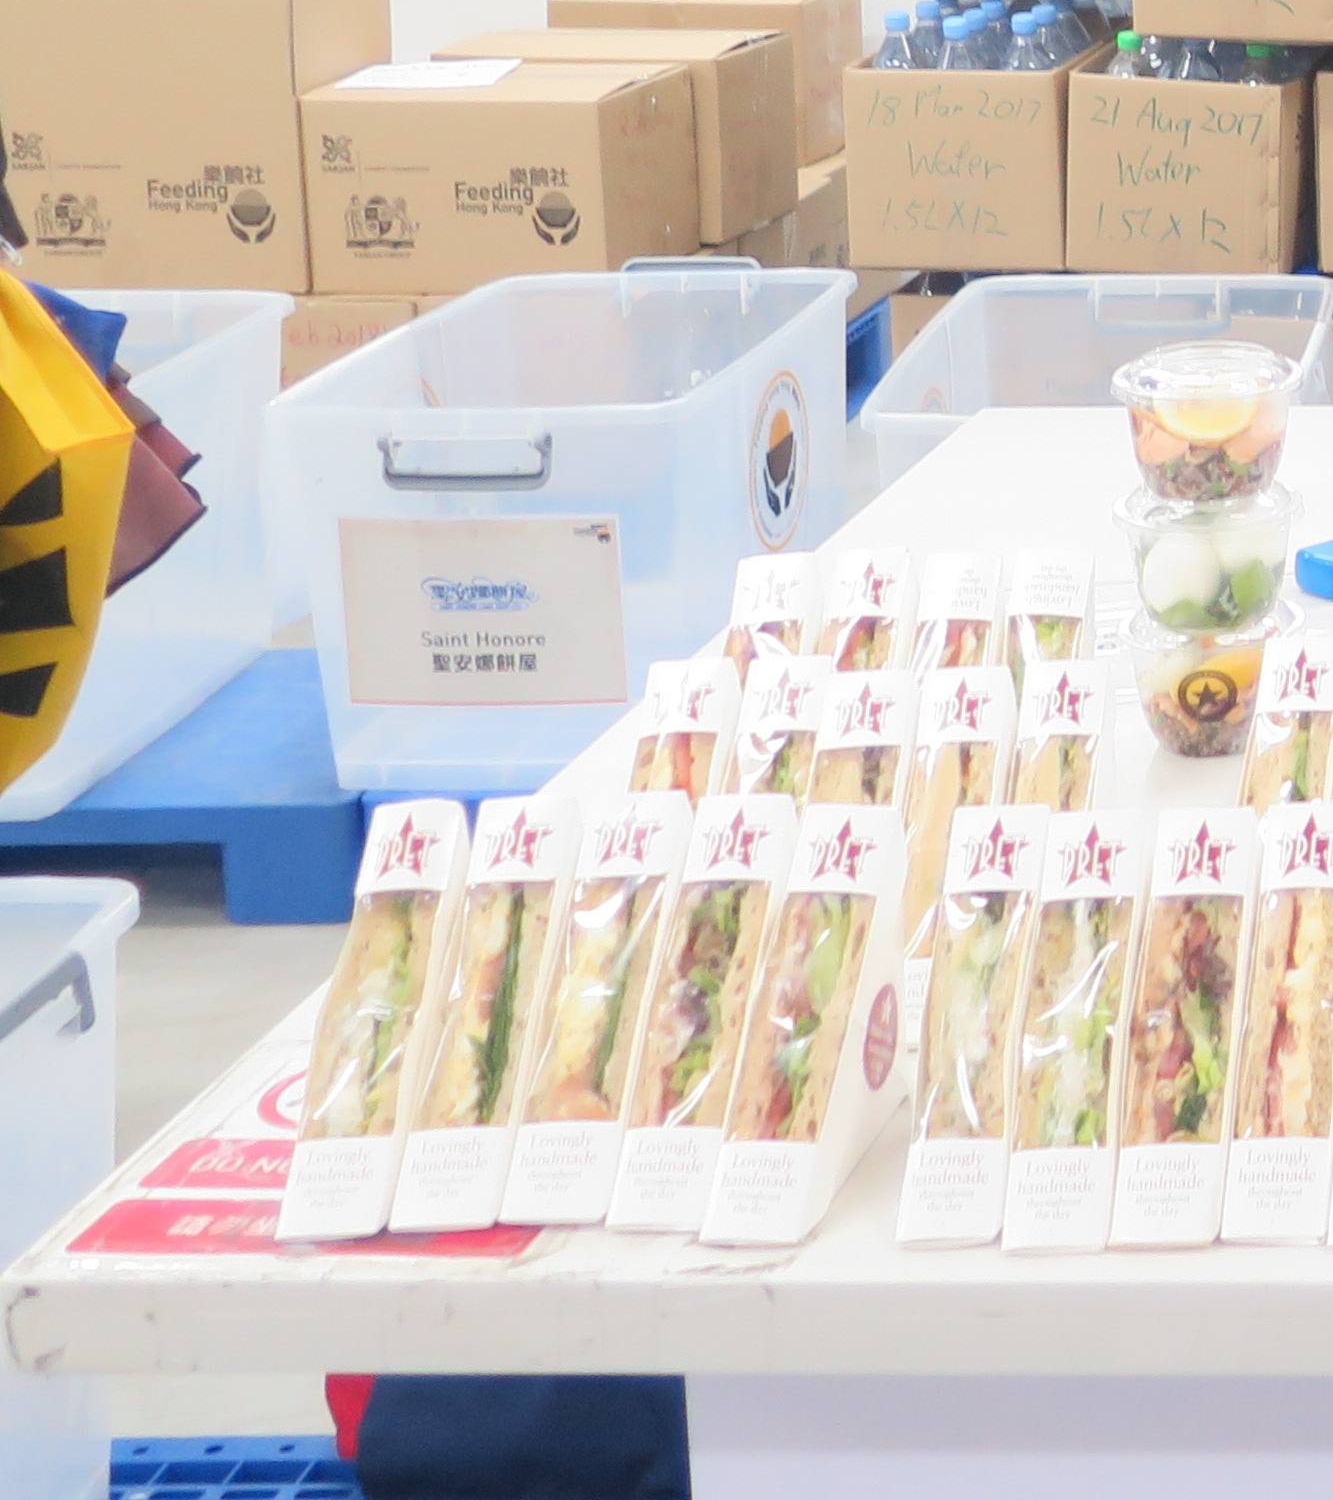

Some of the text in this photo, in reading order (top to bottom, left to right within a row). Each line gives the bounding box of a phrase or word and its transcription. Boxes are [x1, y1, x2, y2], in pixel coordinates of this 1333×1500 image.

[868, 90, 899, 127] 18
[978, 97, 1041, 127] 2017
[1091, 96, 1265, 146] 21 Aug 2017
[907, 142, 1007, 180] Water
[1115, 152, 1202, 187] Water
[147, 180, 228, 203] Feeding
[148, 200, 218, 213] Hong Kong
[454, 181, 534, 205] Feeding
[455, 201, 523, 215] Hong Kong
[421, 630, 546, 648] Saint Honore
[1274, 664, 1330, 696] PRET
[836, 693, 894, 730] PRET
[932, 689, 991, 729] PRET
[1034, 682, 1094, 722] PRET
[486, 829, 553, 864] PRET
[702, 829, 770, 864] PRET
[810, 836, 878, 875] PRET
[962, 836, 1030, 875] PRET
[1058, 840, 1126, 880] PRET
[1168, 838, 1236, 880] PRET
